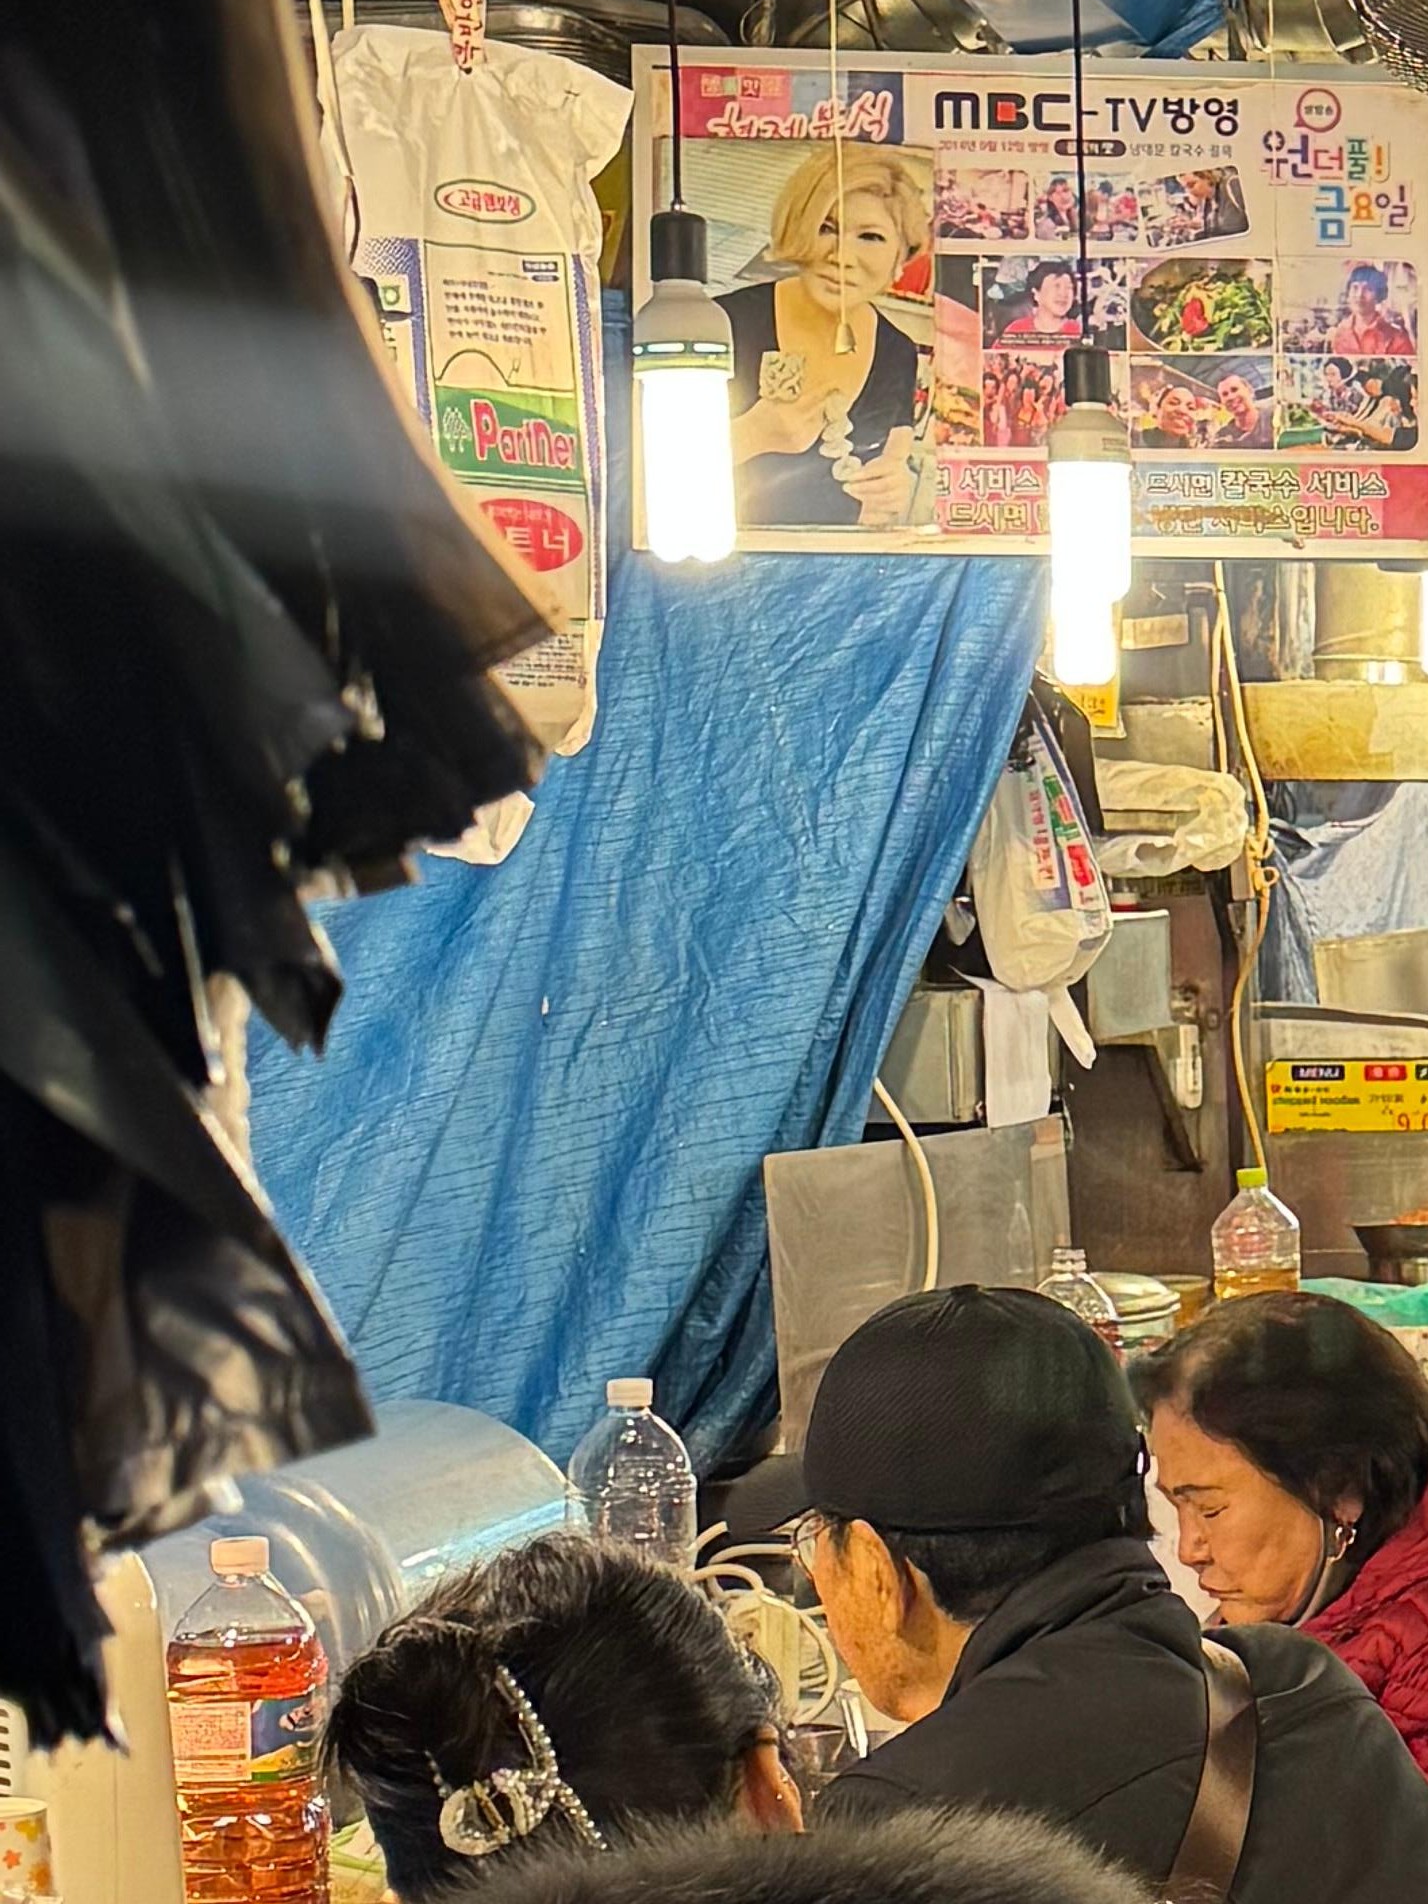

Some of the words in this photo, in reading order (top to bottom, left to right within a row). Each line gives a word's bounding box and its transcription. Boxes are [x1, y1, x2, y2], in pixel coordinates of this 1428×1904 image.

[1315, 185, 1408, 240] 금요일
[470, 398, 577, 471] Partner
[1220, 469, 1300, 500] 칼국수
[1306, 468, 1388, 498] 서비스
[504, 526, 570, 562] 트너
